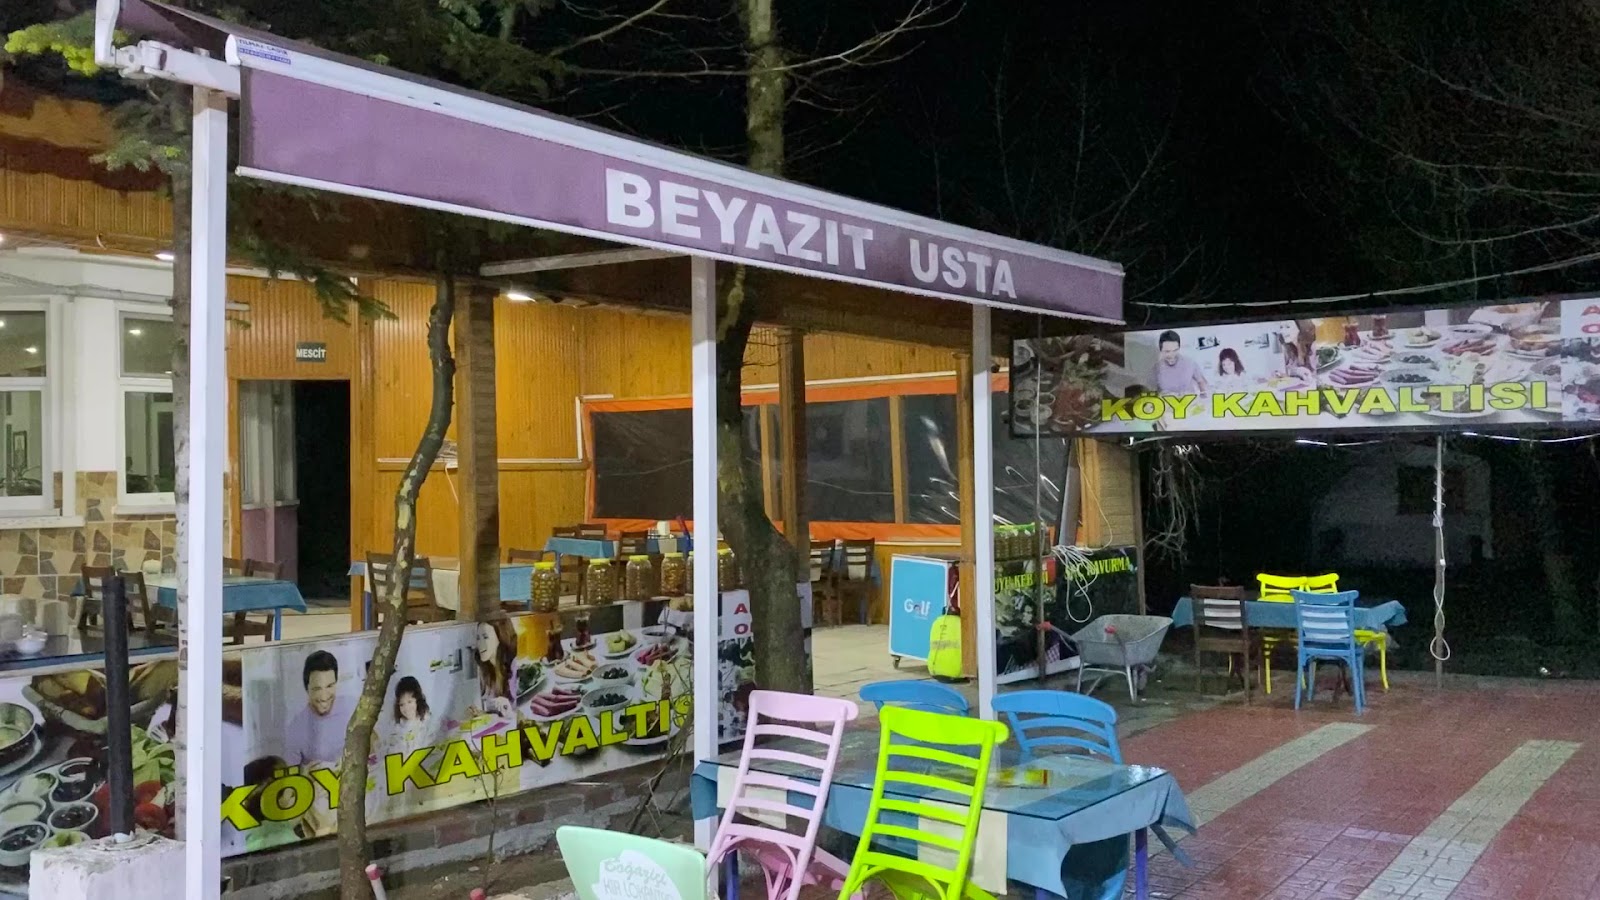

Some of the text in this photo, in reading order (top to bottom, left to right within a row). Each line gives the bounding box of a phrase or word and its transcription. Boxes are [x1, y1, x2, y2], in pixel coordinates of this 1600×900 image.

[605, 167, 1018, 299] BEYAZIT USTA
[296, 346, 327, 359] MESCİT
[1101, 380, 1548, 422] KÖY KAHVALTISI
[384, 694, 693, 796] KAHVALTIS
